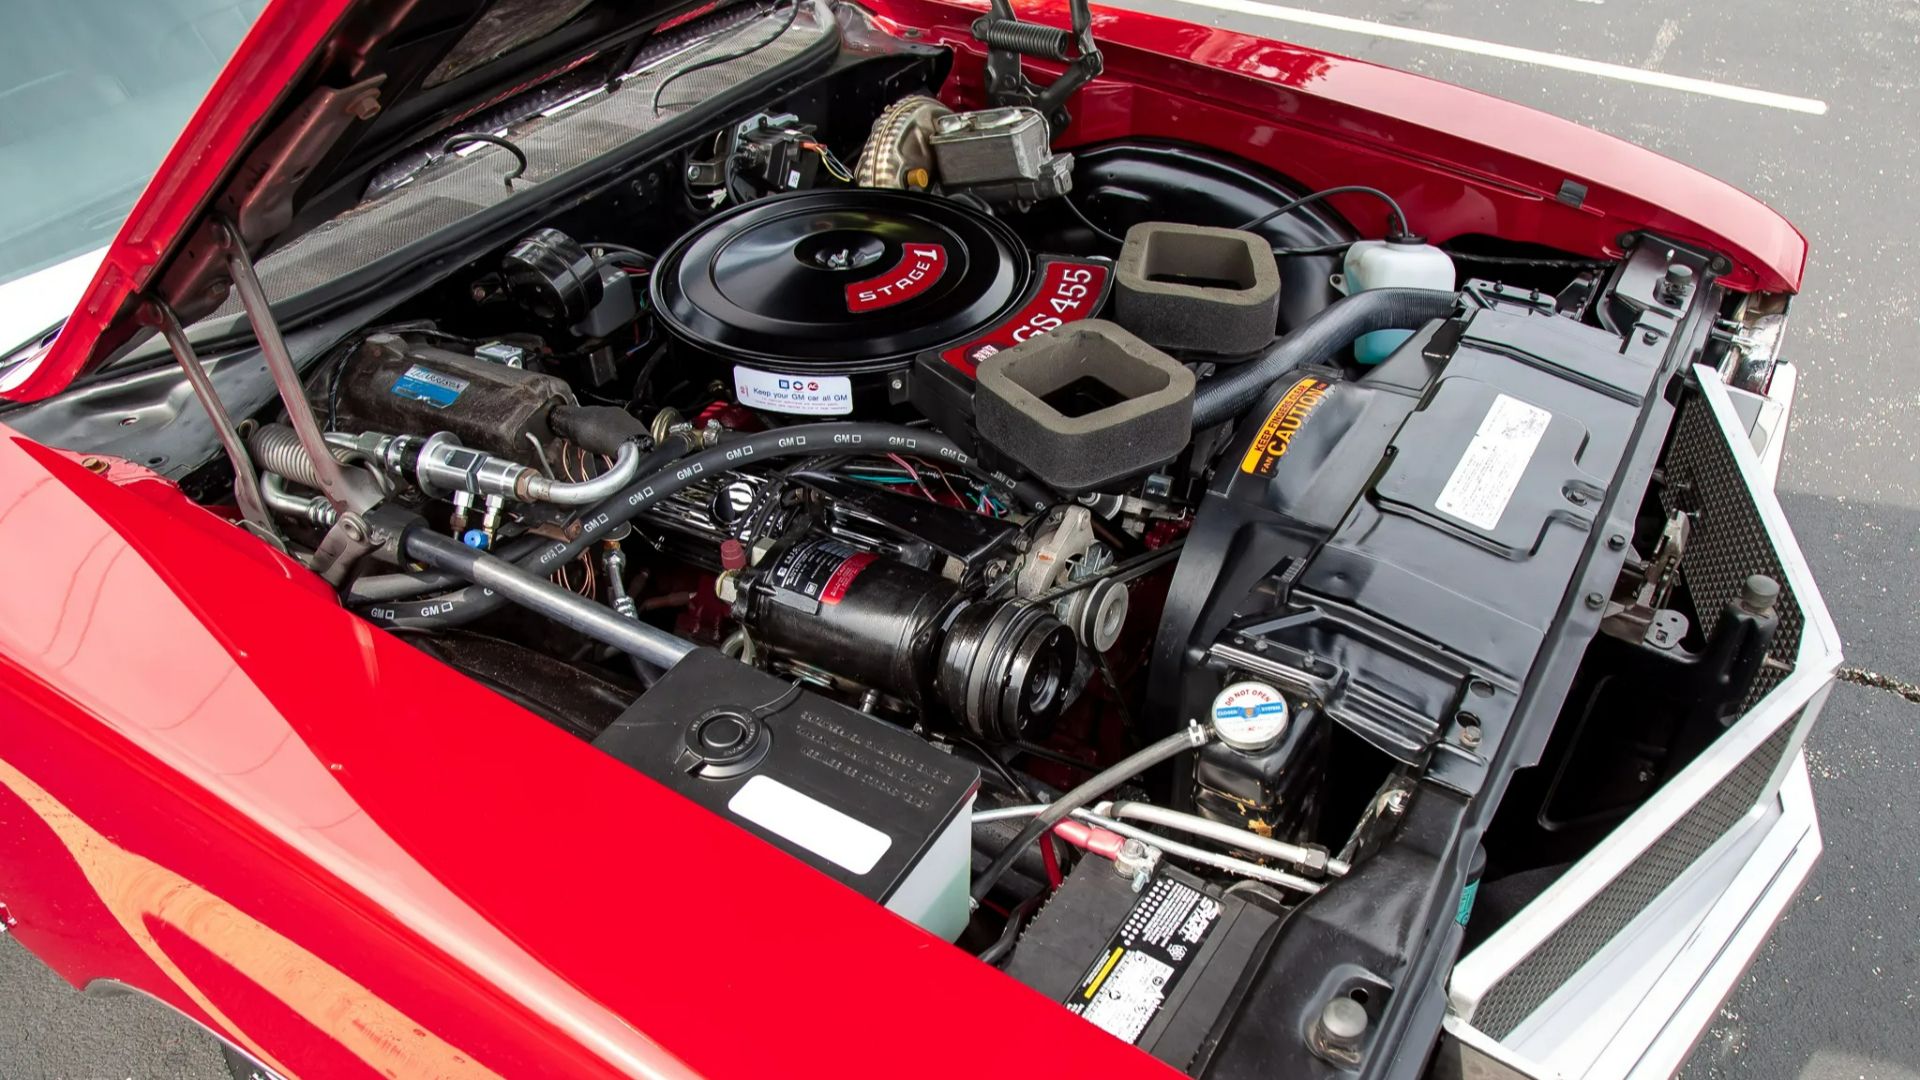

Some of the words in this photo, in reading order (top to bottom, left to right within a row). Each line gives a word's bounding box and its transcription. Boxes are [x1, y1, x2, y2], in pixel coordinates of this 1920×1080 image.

[858, 261, 931, 302] STAGE
[1012, 313, 1063, 343] GS
[1050, 269, 1092, 313] 455
[753, 387, 771, 397] Keep
[773, 391, 788, 400] your
[1254, 430, 1271, 452] KEEP
[1268, 400, 1293, 428] FINGERS
[1289, 385, 1305, 401] CLEAR
[1267, 387, 1326, 456] CAUTION
[778, 438, 795, 447] GM
[834, 434, 850, 443] GM
[888, 436, 905, 446] GM
[726, 448, 743, 460] GM
[940, 447, 957, 460] GM
[1261, 456, 1274, 473] FAN
[676, 467, 693, 480] GM
[628, 491, 645, 505] GM
[583, 520, 600, 533] GM
[540, 548, 558, 563] GM
[370, 607, 385, 619] GM
[421, 604, 439, 617] GM
[1225, 696, 1235, 706] DO
[1234, 689, 1249, 698] NOT
[1252, 689, 1271, 702] OPEN
